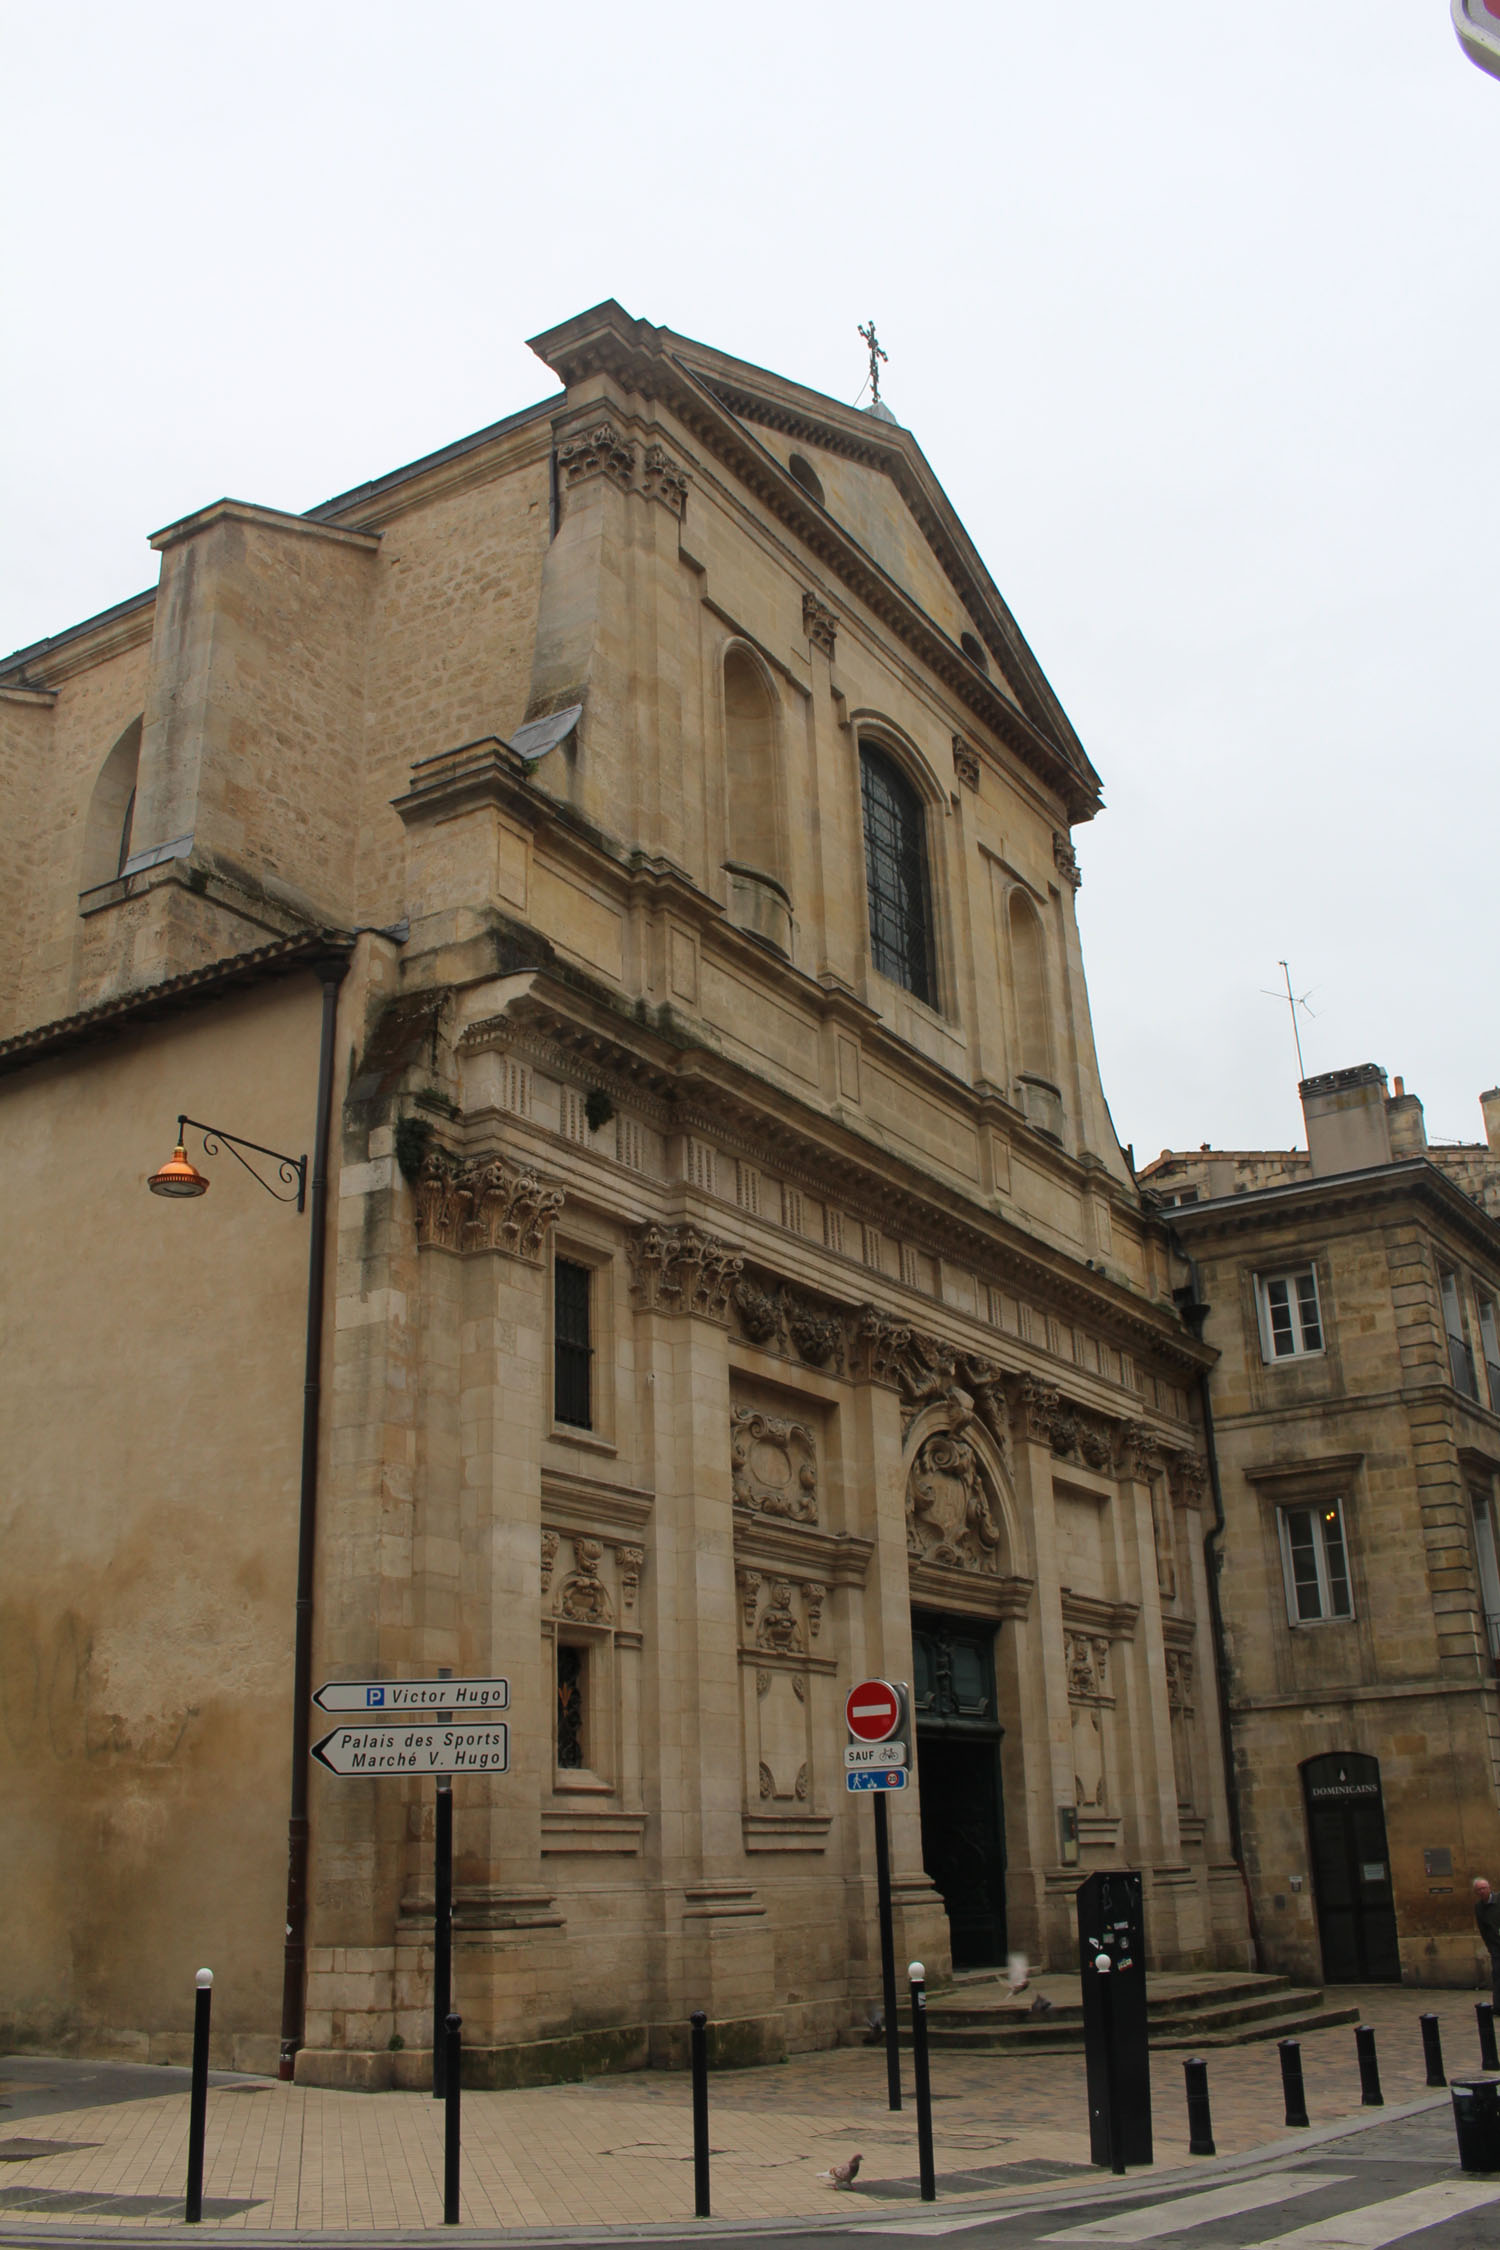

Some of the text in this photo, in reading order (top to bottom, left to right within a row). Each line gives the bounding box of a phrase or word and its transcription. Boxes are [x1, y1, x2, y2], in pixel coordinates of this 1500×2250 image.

[369, 1688, 501, 1705] P Victor Hugo
[341, 1732, 500, 1749] Palais des Sports
[352, 1750, 500, 1767] Marché V. Hugo
[849, 1751, 874, 1761] SAUF
[1313, 1784, 1377, 1796] DOMINICAINS
